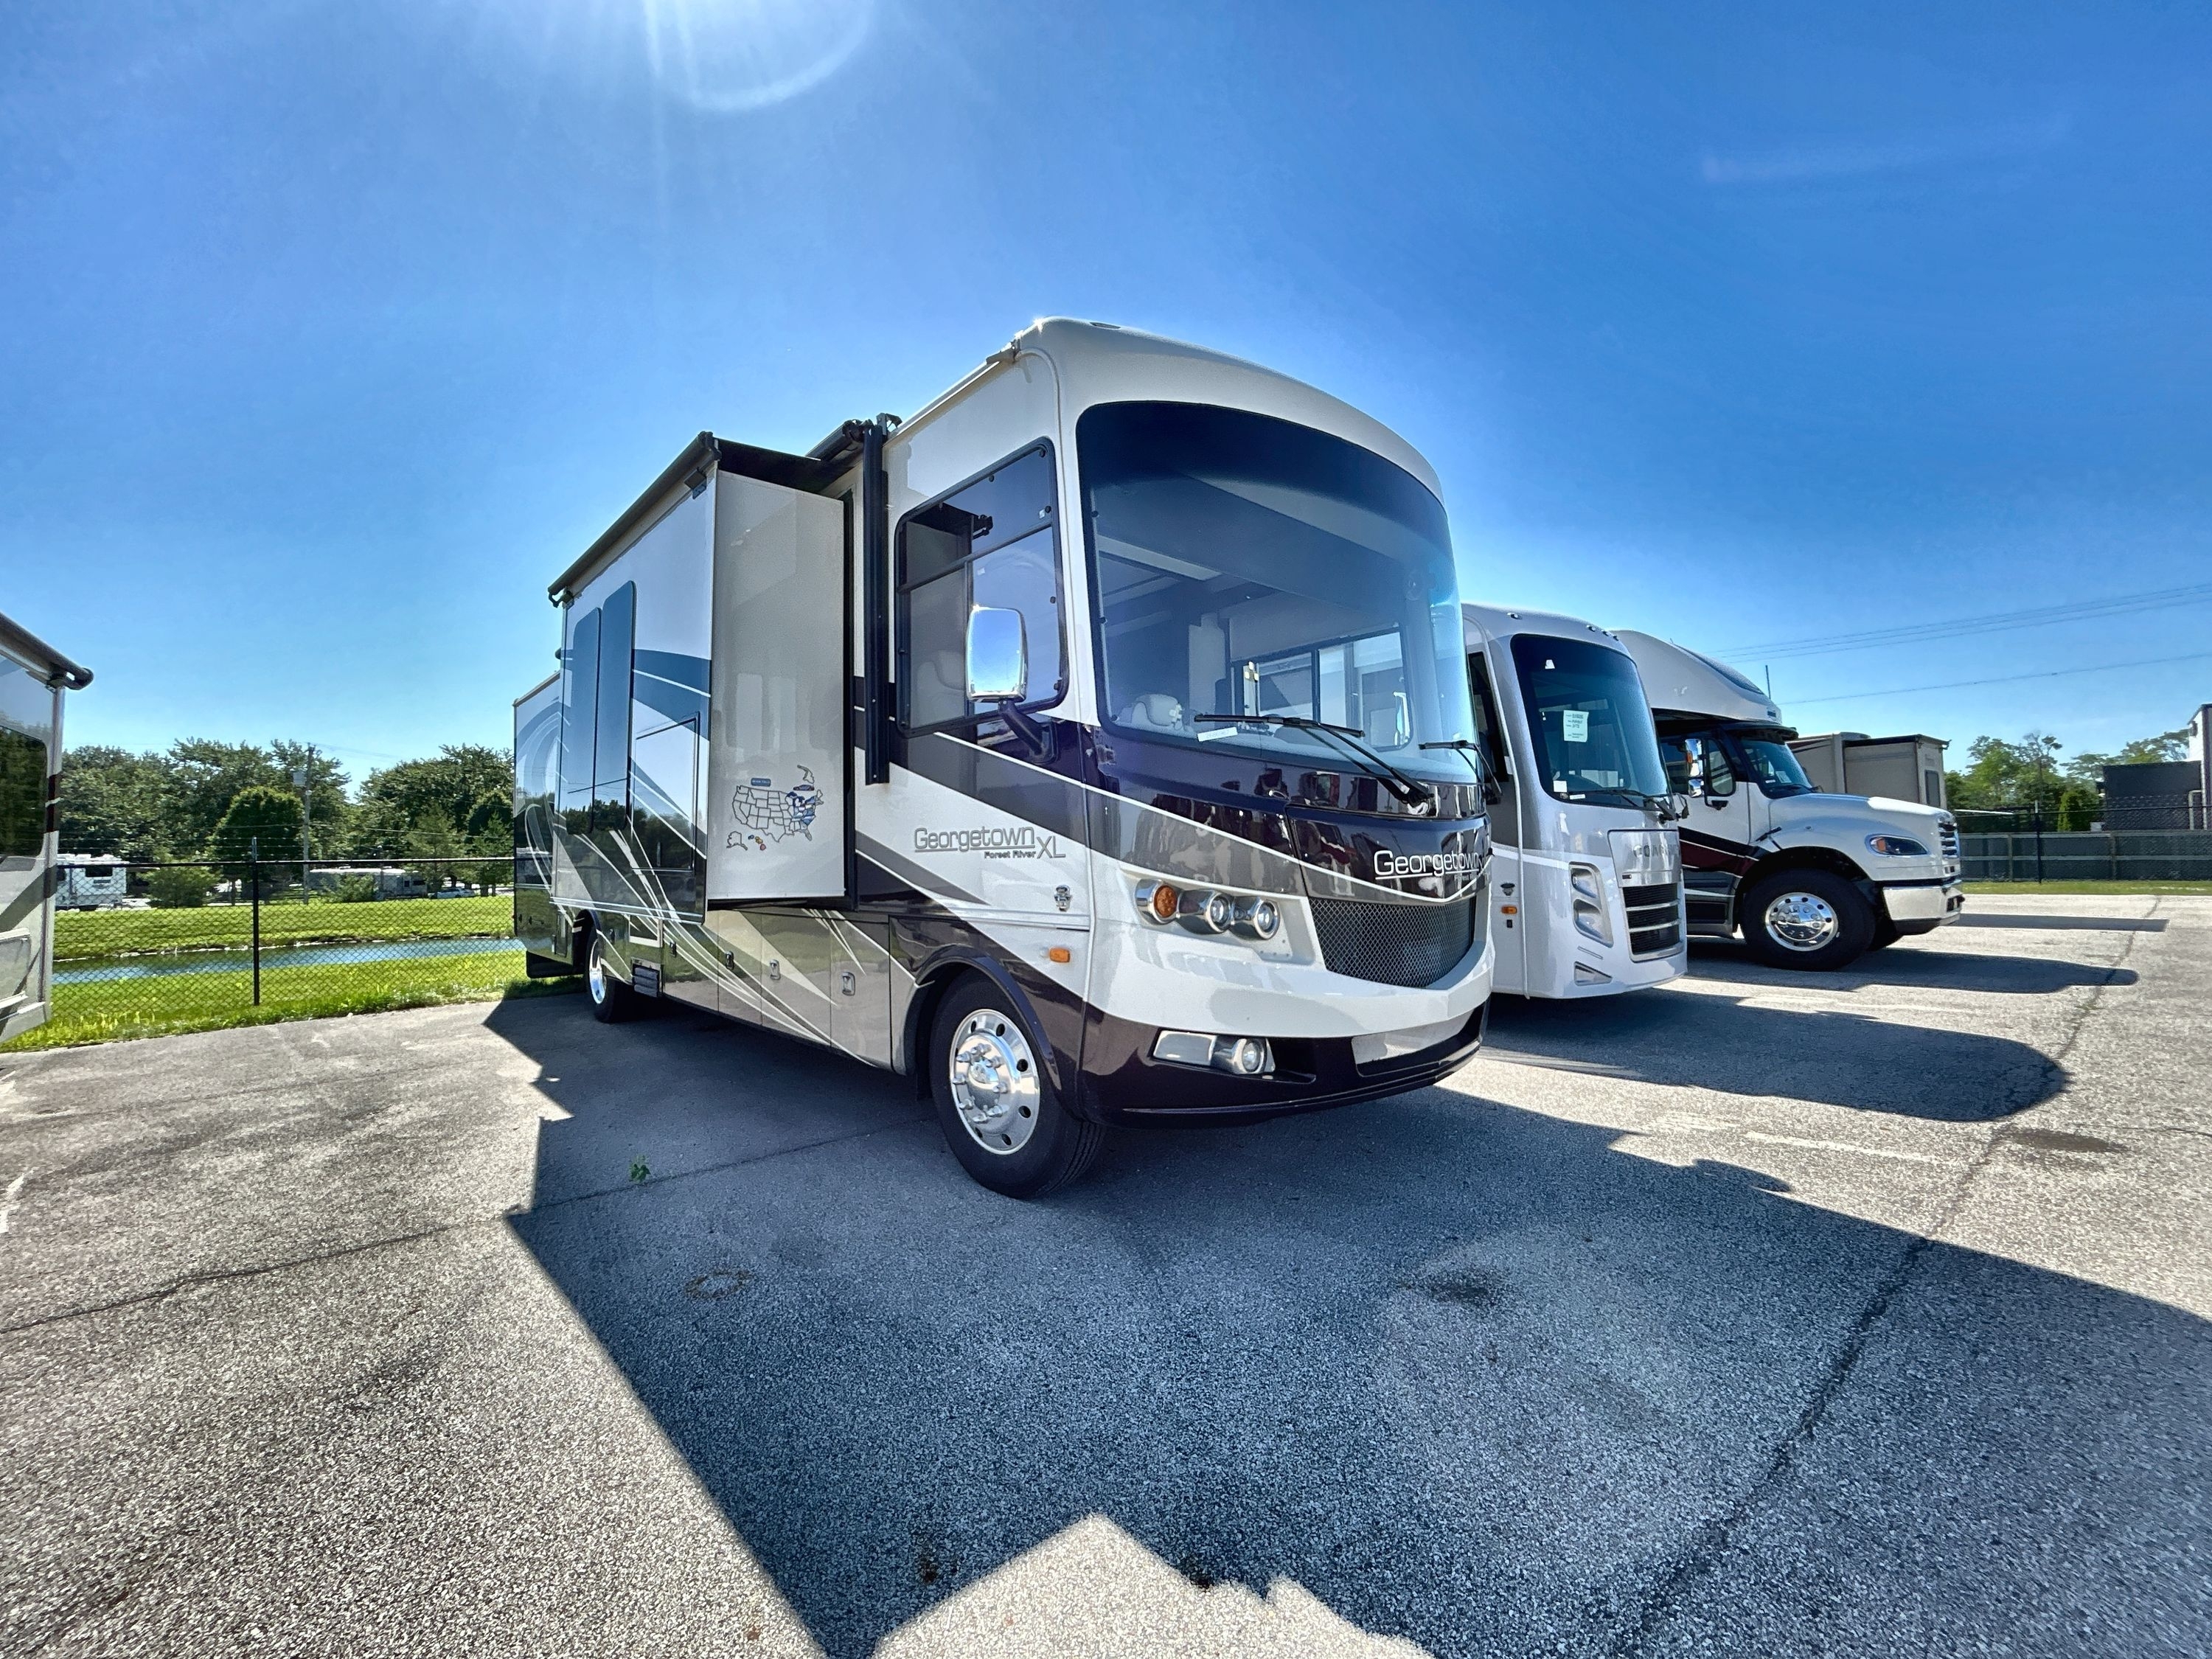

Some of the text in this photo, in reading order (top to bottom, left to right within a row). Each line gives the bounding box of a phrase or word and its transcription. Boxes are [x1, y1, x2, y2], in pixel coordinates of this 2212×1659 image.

[914, 826, 1066, 859] Georgetown XL
[984, 850, 1036, 859] Forest River
[1374, 850, 1479, 876] Georgetown
